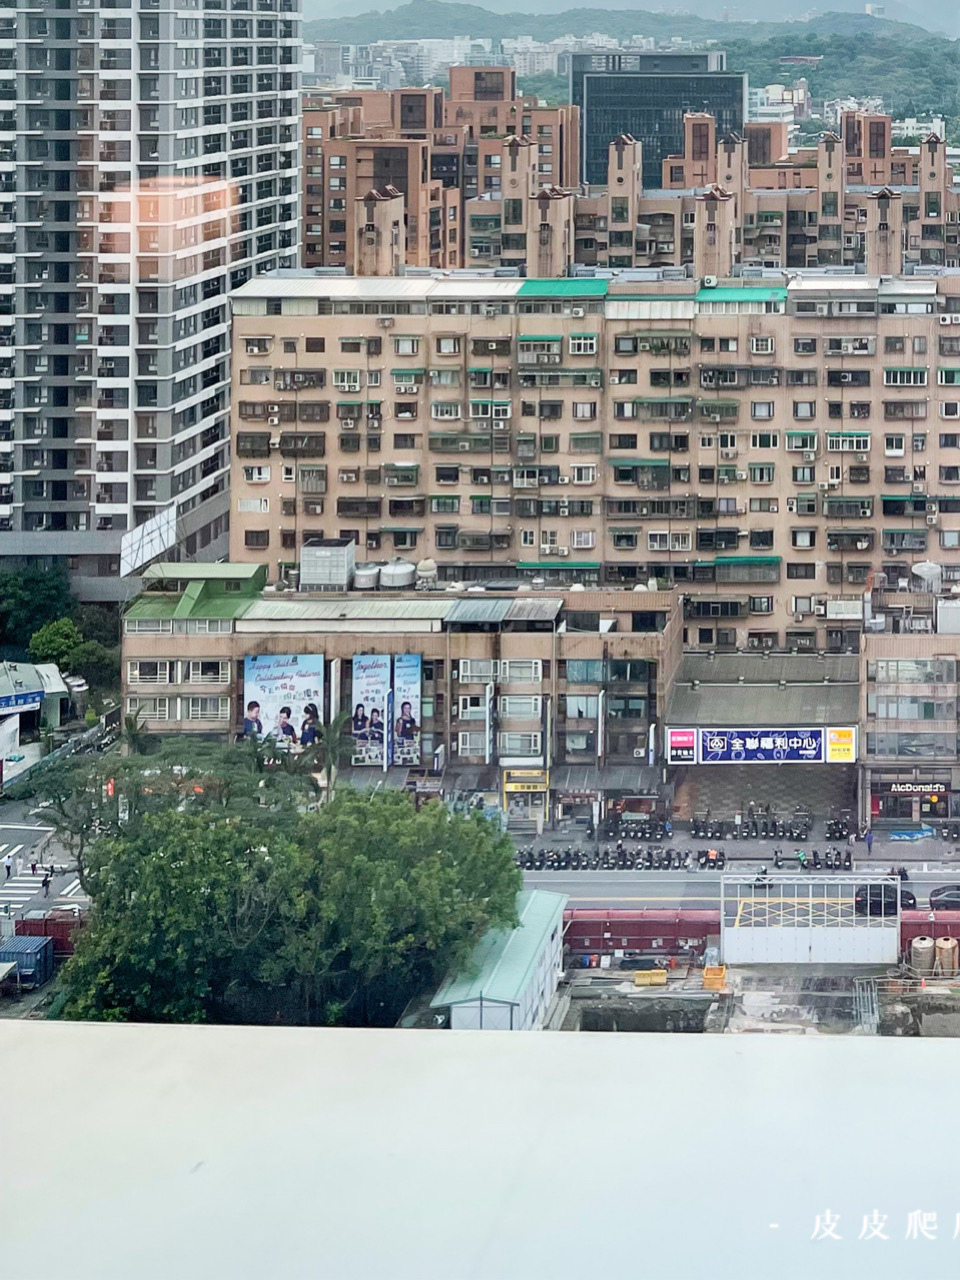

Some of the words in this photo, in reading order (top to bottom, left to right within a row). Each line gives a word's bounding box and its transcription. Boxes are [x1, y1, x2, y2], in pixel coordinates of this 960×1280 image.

[731, 737, 817, 750] 全聯福利中心
[891, 783, 945, 792] McDonald's
